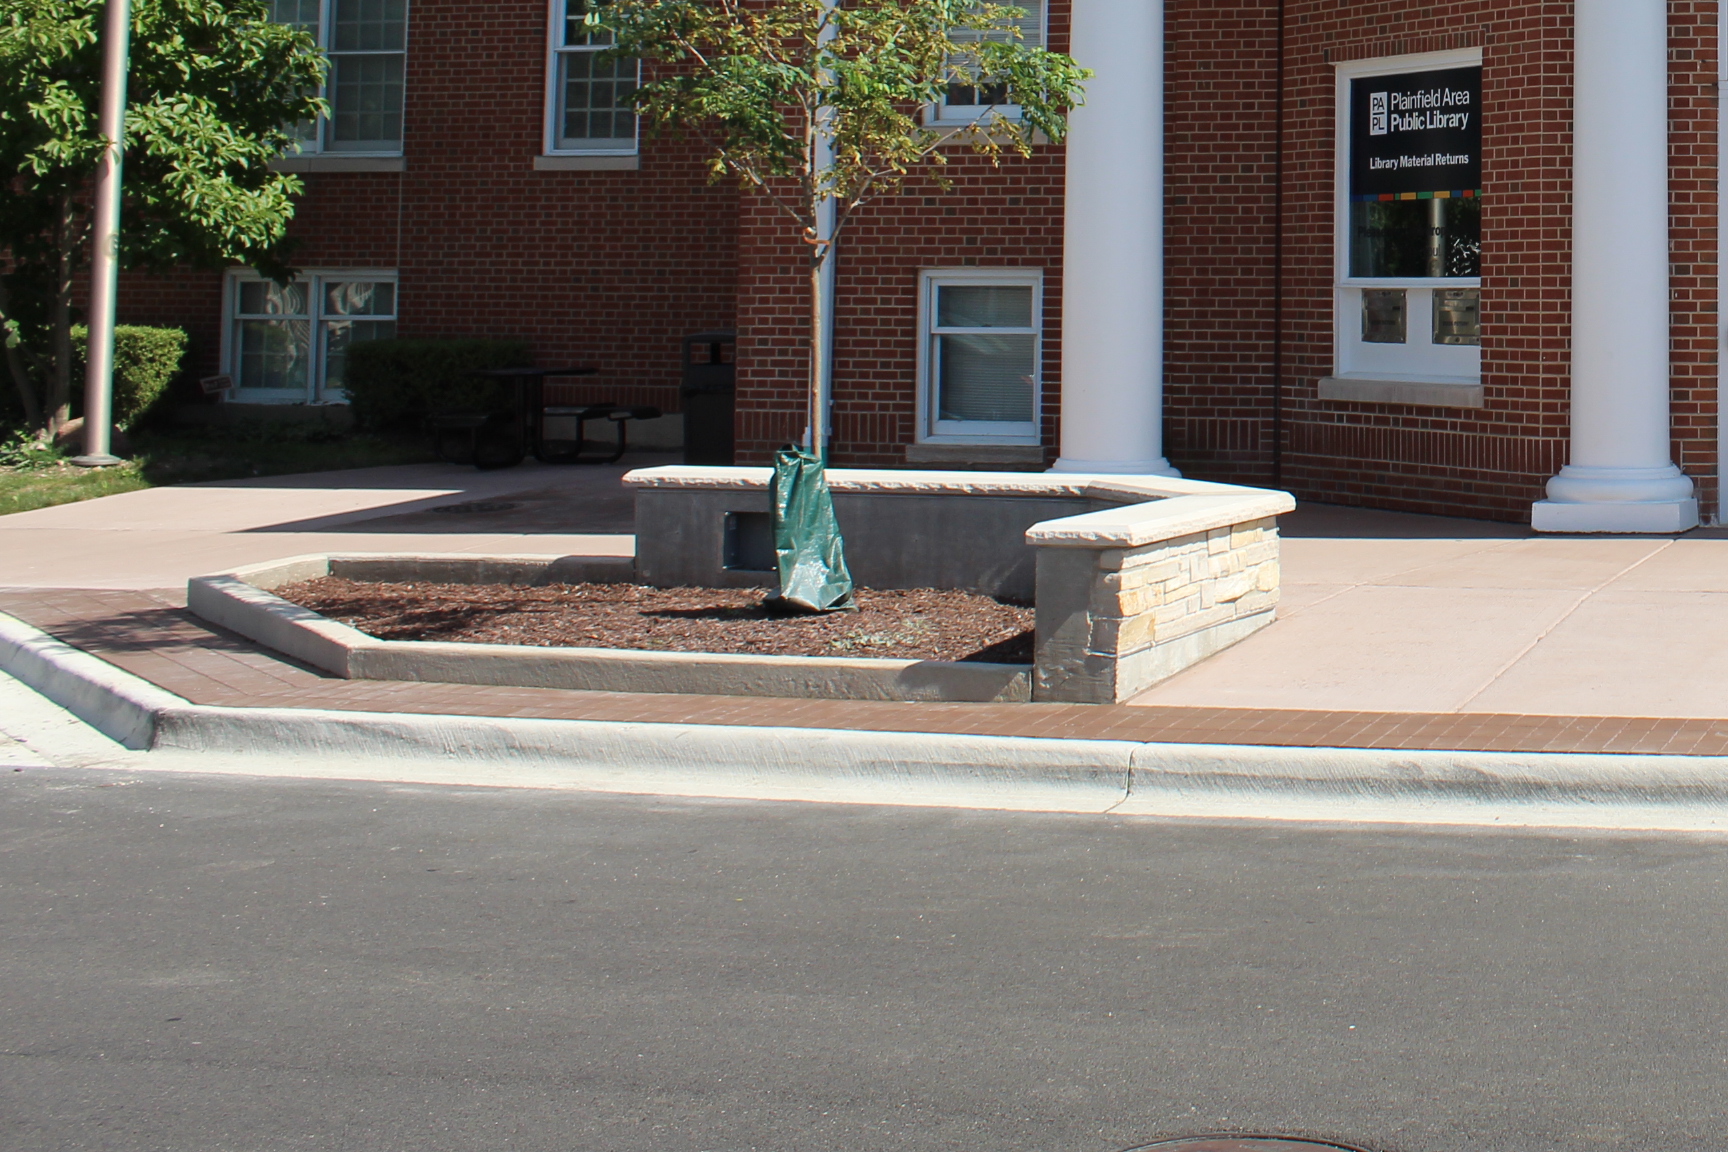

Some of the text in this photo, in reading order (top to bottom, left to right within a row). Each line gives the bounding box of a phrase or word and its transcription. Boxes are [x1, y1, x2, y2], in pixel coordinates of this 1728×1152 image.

[1372, 97, 1385, 111] PA
[1391, 87, 1470, 111] Plainfield Area
[1372, 117, 1385, 131] PL
[1390, 110, 1469, 132] Public Library
[1370, 153, 1469, 170] Library Material Returns
